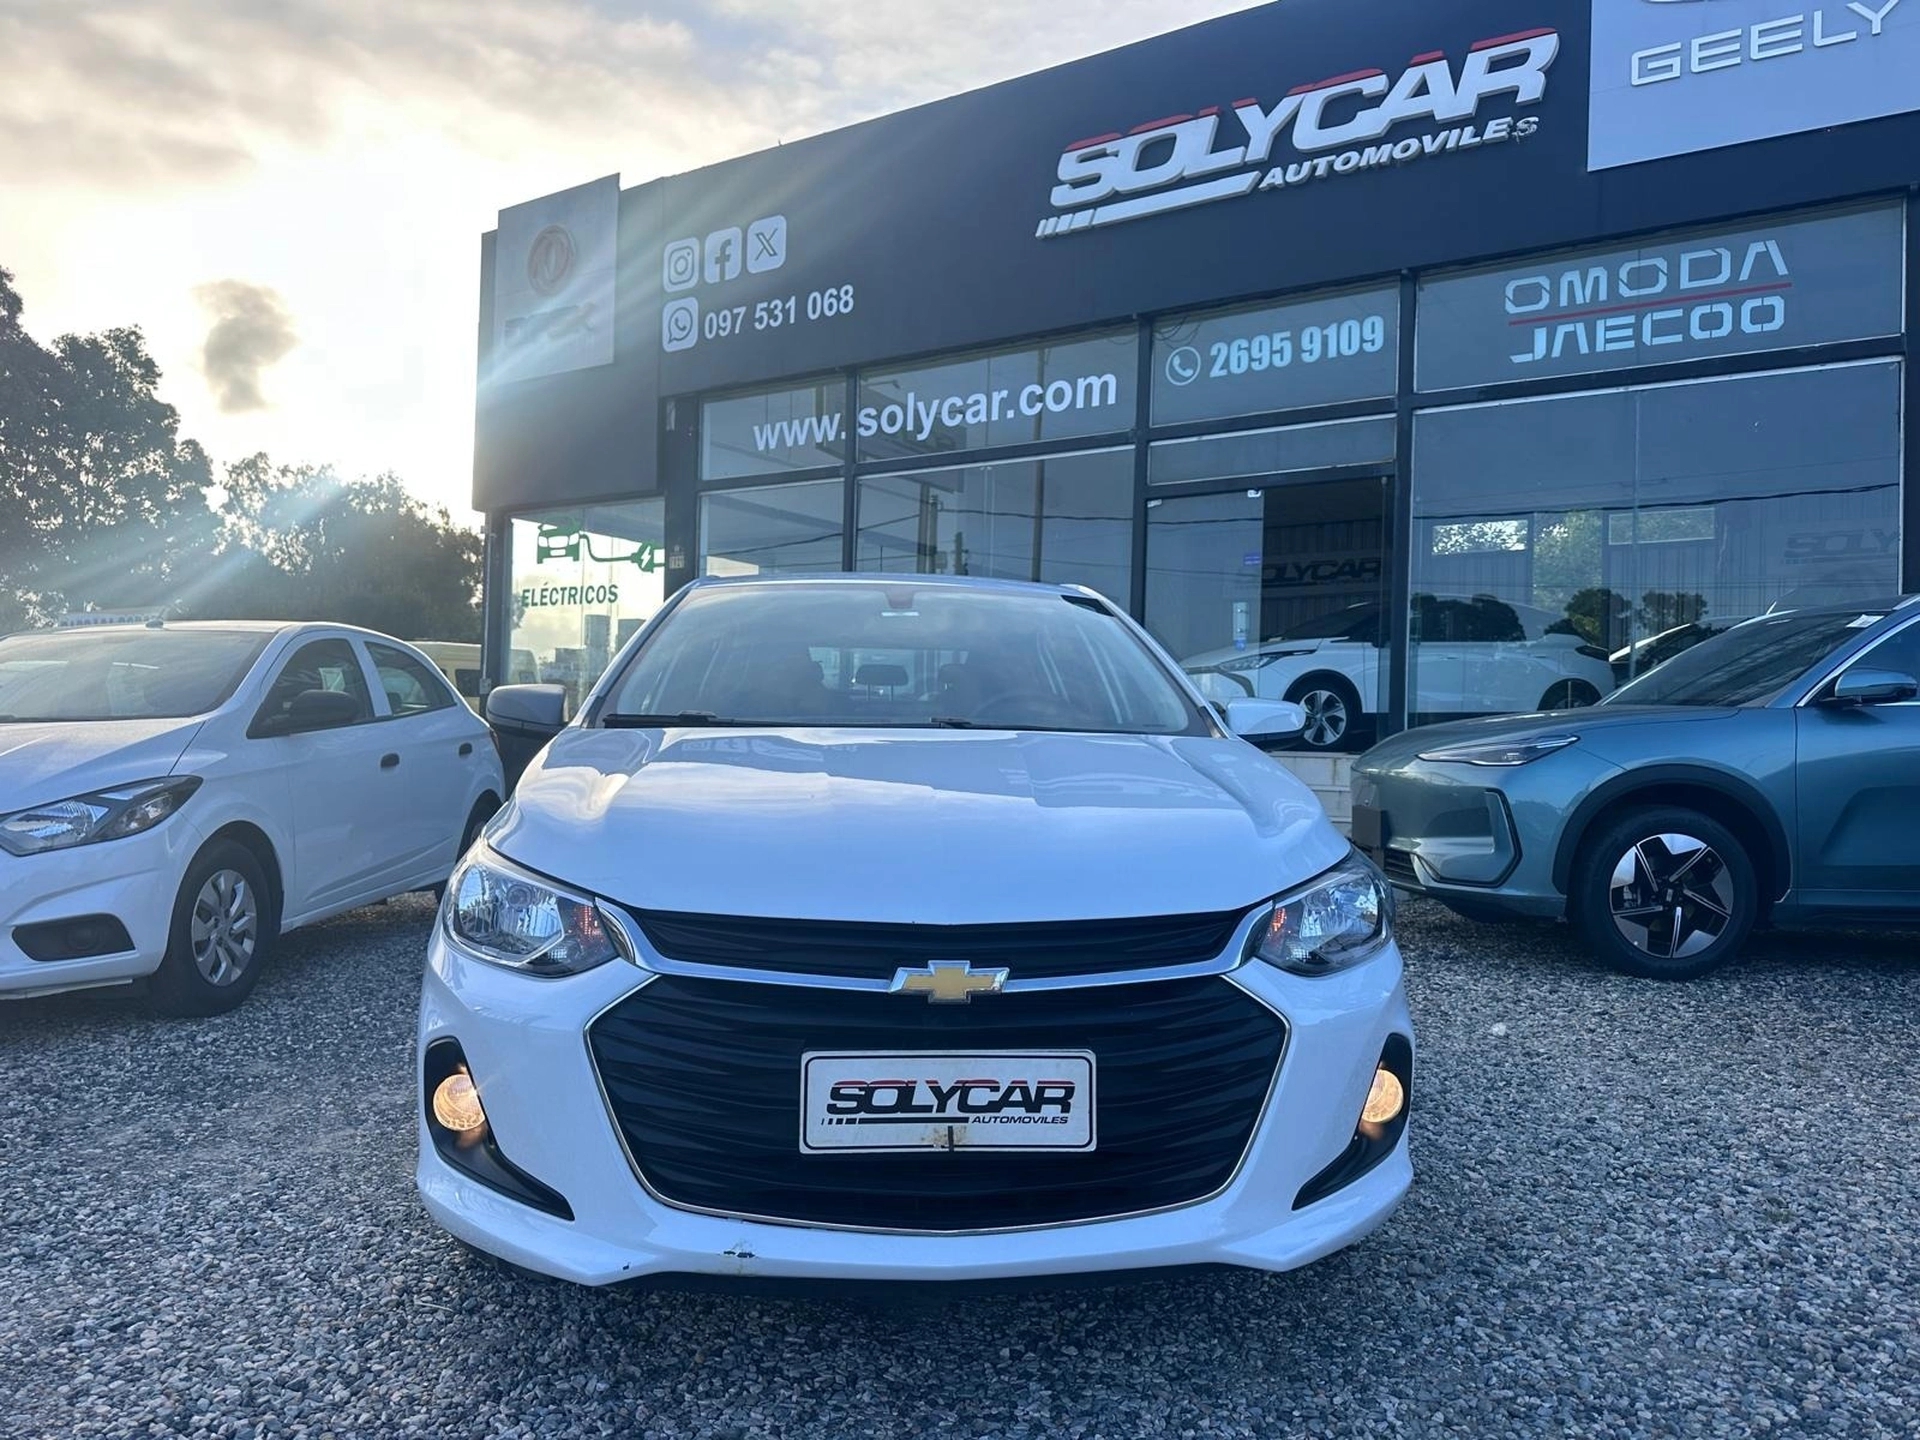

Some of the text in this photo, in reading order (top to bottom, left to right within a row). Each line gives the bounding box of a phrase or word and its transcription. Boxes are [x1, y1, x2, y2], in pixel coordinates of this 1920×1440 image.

[1631, 0, 1900, 86] GEELY
[1050, 27, 1560, 207] SOLYCAR
[1259, 116, 1540, 190] AUTOMOVILES
[1504, 239, 1789, 314] OMODA
[704, 284, 854, 339] 097 531 068
[1509, 295, 1785, 364] JAECOO
[1209, 315, 1385, 378] 2695 9109
[521, 581, 619, 608] ELÉCTRICOS
[826, 1079, 1076, 1115] SOLYCAR
[971, 1115, 1069, 1125] AUTOMOVILES
